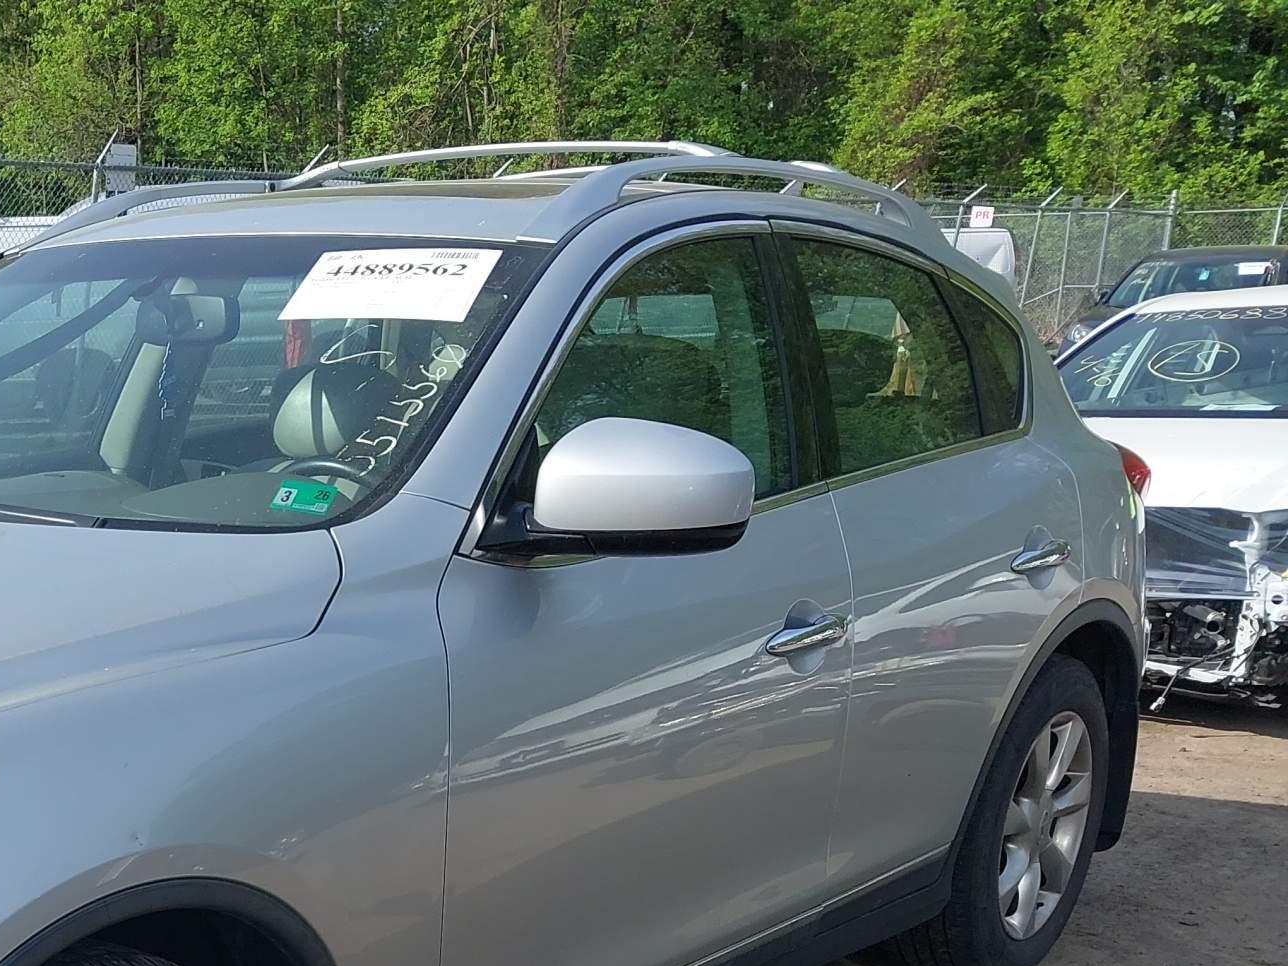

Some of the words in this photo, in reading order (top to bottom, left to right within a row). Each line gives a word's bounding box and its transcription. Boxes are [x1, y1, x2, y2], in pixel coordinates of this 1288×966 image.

[975, 211, 990, 219] PR
[326, 263, 468, 277] 44889562
[280, 489, 293, 503] 3
[314, 489, 332, 501] 26
